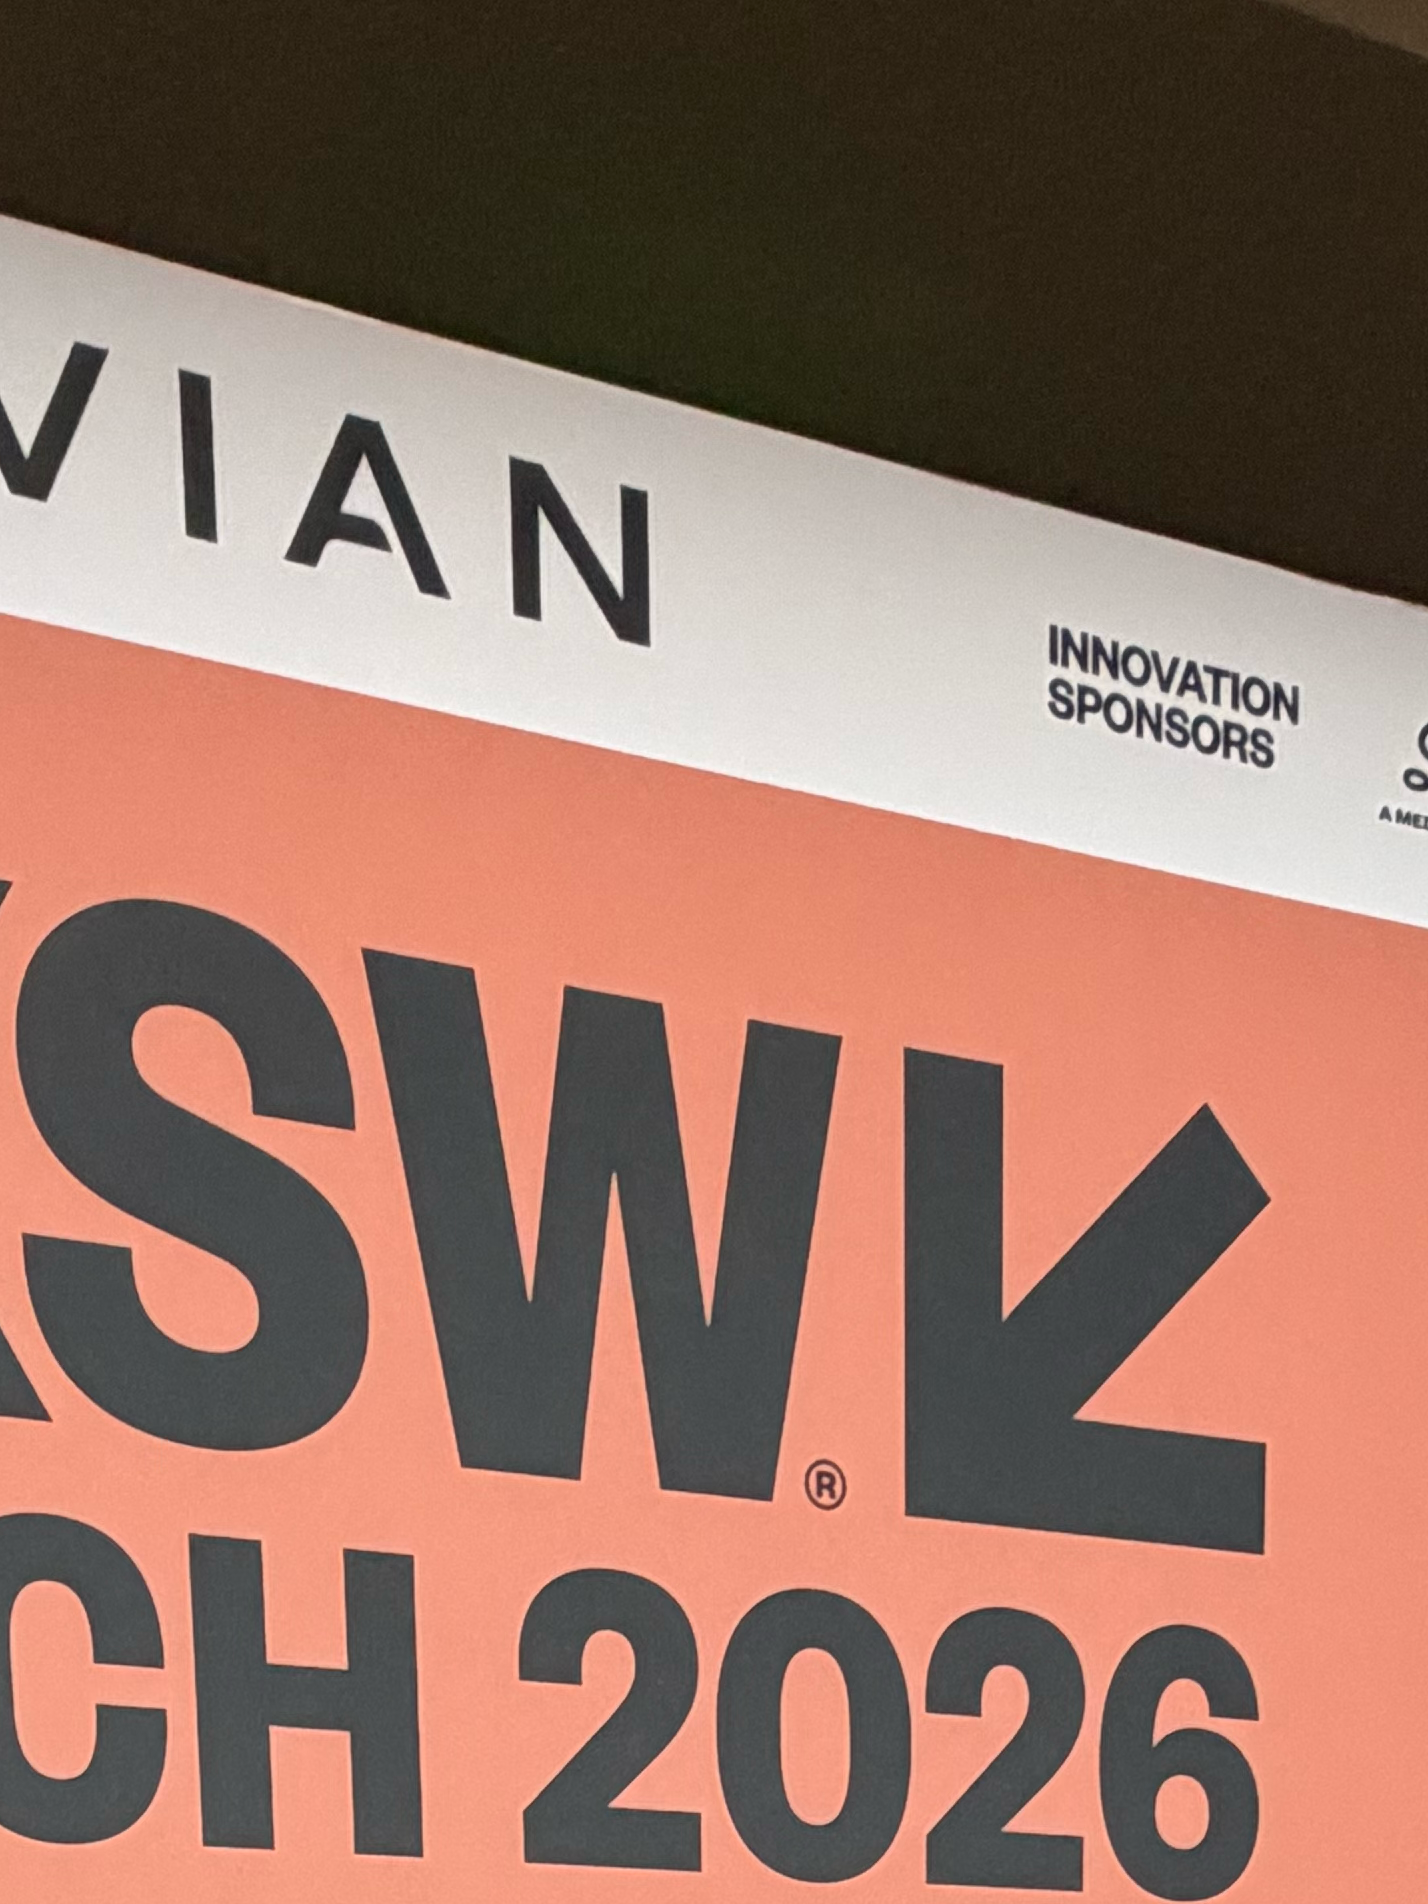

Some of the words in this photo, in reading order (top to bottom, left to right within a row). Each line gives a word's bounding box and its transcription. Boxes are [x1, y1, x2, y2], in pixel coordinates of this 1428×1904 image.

[1047, 677, 1276, 769] SPONSORS
[1048, 624, 1300, 726] INNOVATION
[1379, 806, 1392, 822] A
[519, 1568, 1261, 1902] 2026
